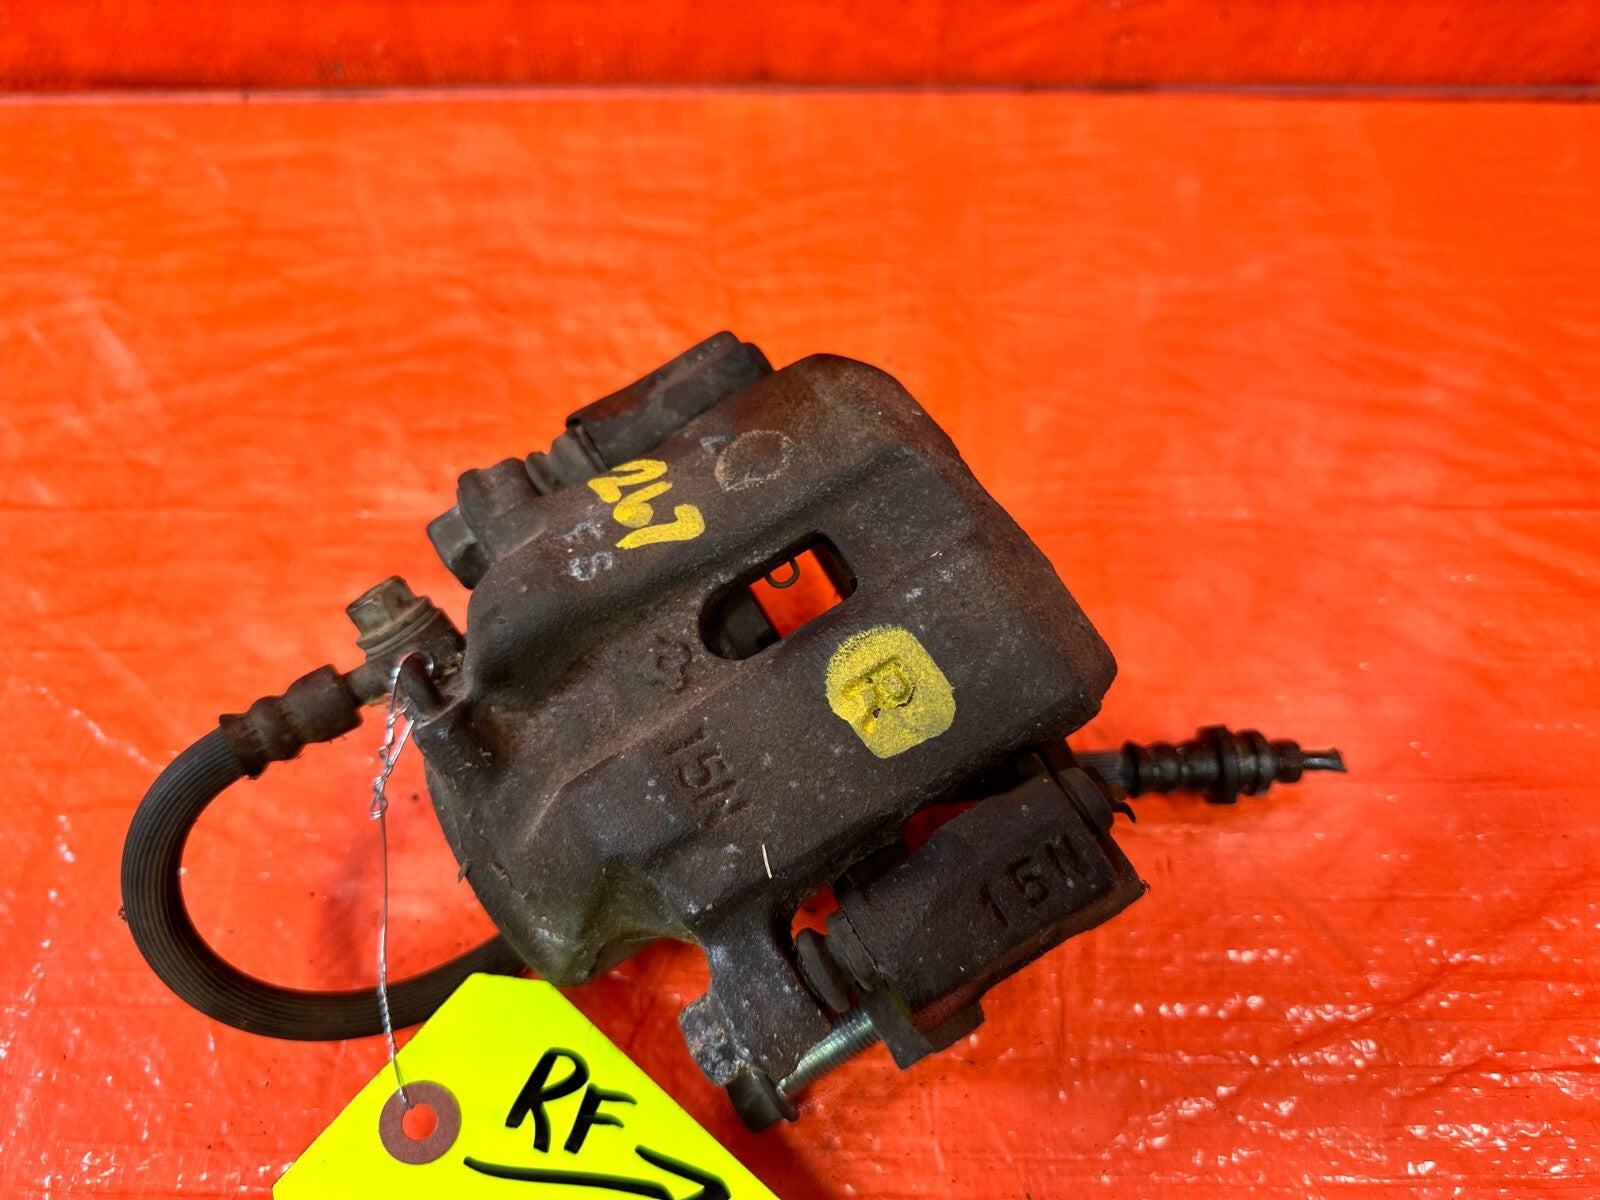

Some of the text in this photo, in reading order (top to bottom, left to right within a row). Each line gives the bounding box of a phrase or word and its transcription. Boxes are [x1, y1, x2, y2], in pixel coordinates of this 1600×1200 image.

[588, 459, 705, 549] 267
[840, 656, 915, 733] R
[666, 720, 751, 829] 15N
[980, 835, 1088, 927] 15N
[505, 1047, 637, 1154] RF
